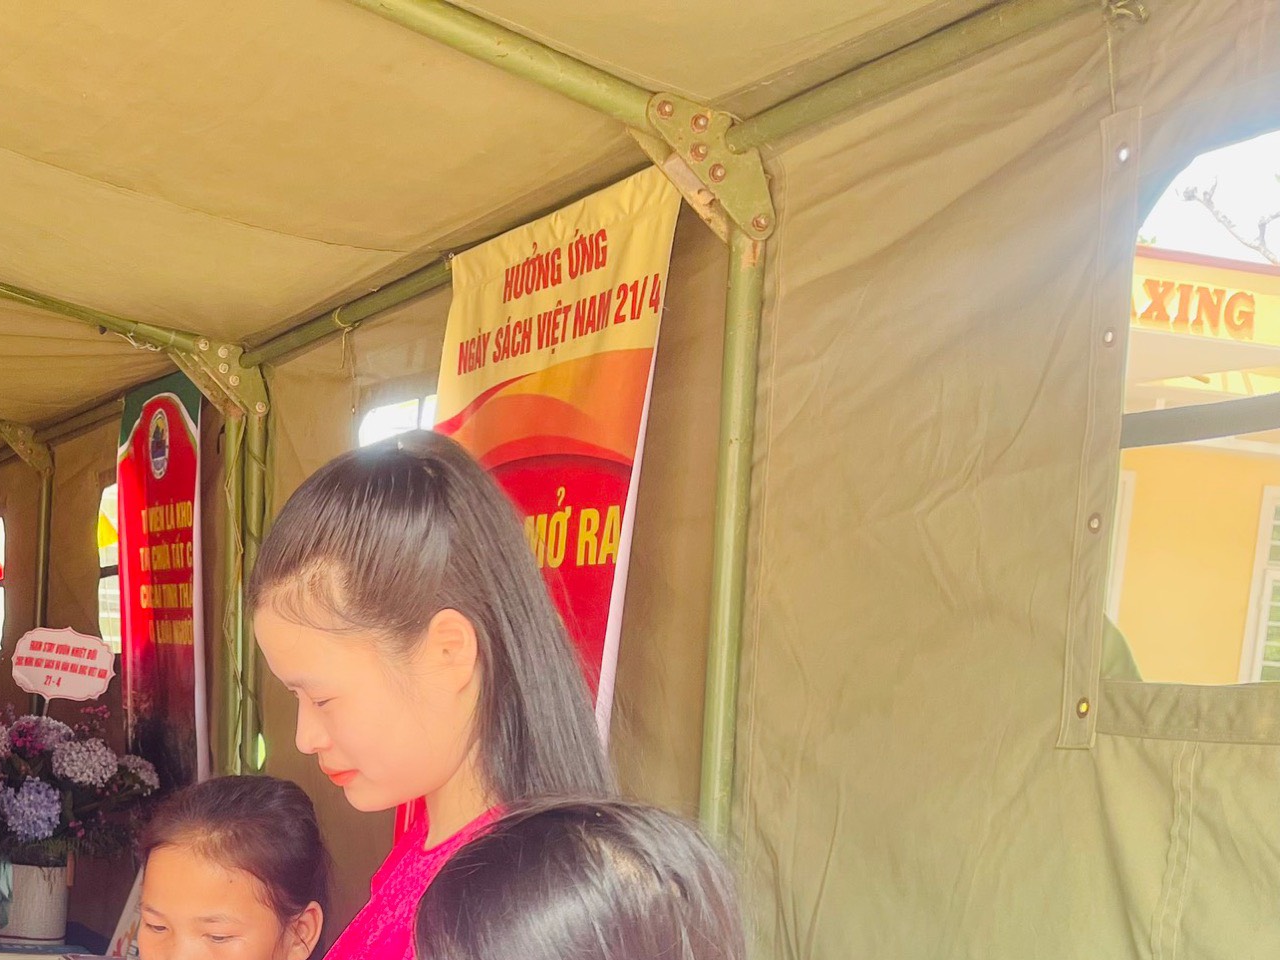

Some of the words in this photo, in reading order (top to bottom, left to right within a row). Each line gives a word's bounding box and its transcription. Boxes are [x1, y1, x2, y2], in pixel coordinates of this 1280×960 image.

[503, 241, 562, 304] HƯỞNG
[568, 228, 608, 280] ỨNG
[457, 328, 491, 376] NGÀY
[493, 316, 533, 363] SÁCH
[537, 300, 572, 354] VIỆT
[572, 289, 613, 339] NAM
[1131, 279, 1256, 340] XING
[523, 486, 572, 569] MỞ
[576, 504, 621, 567] RA
